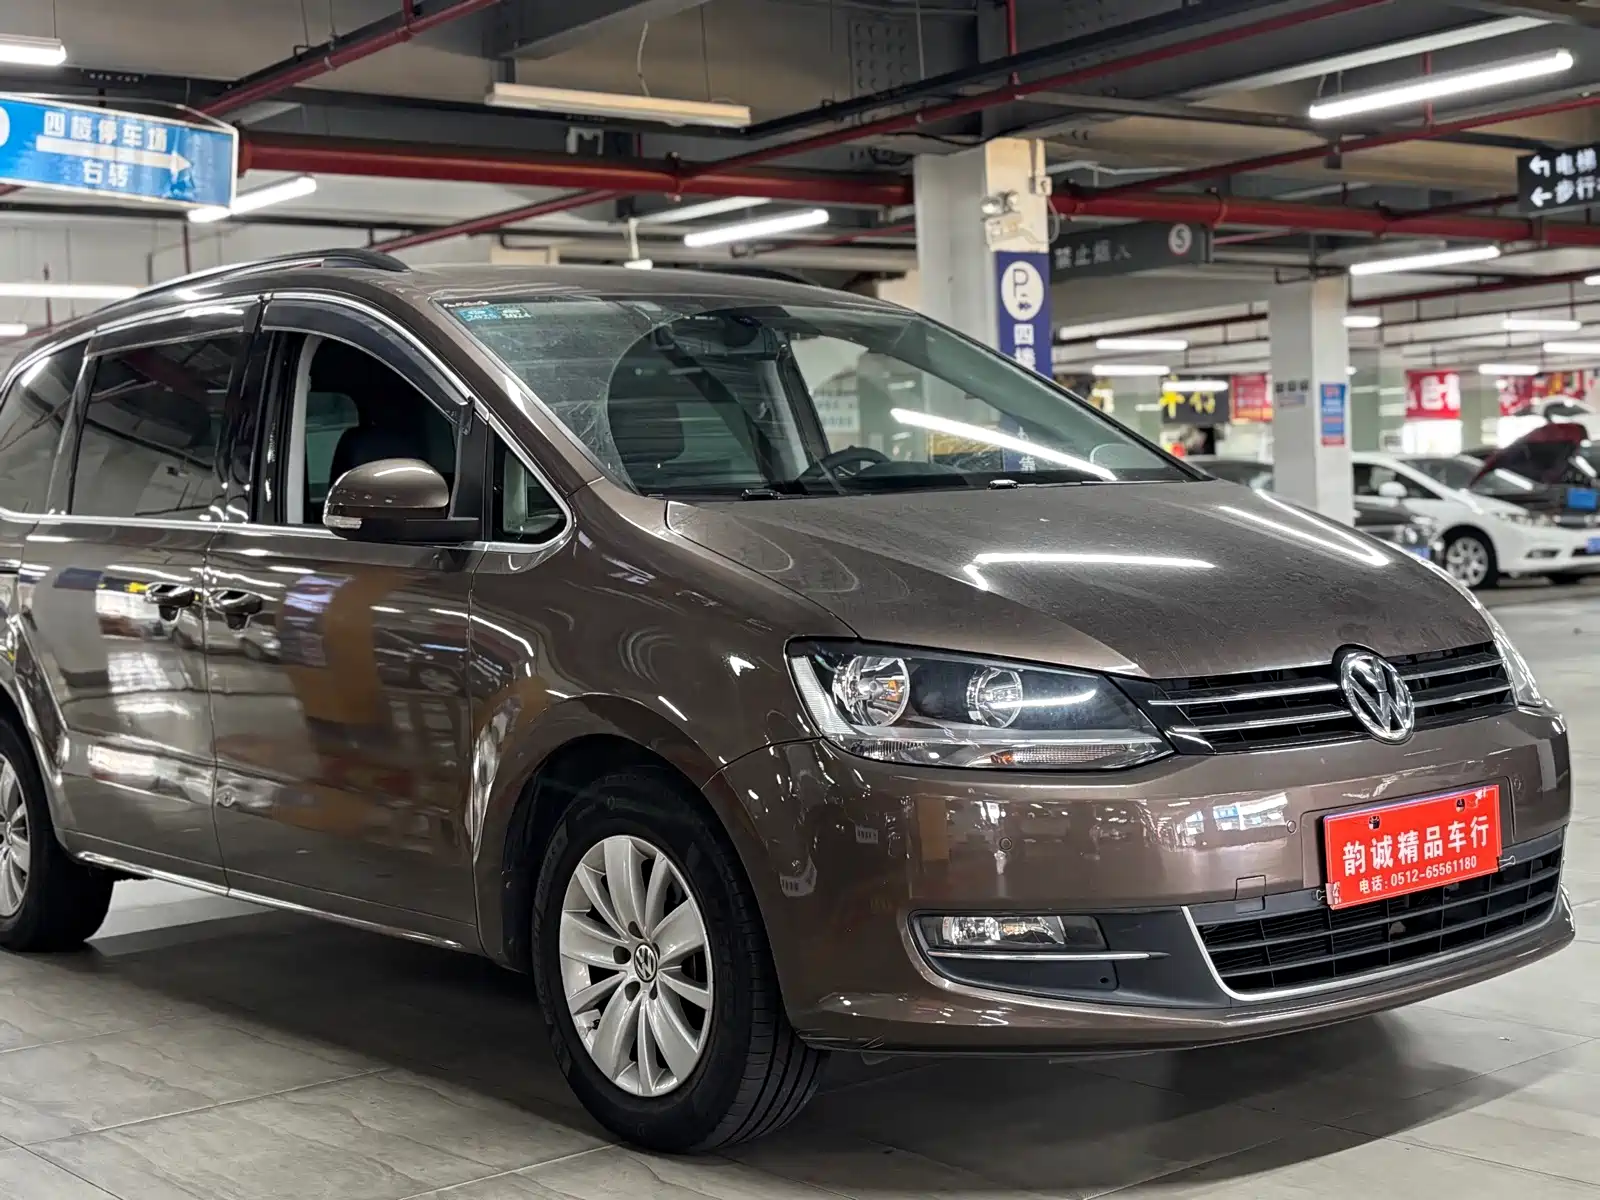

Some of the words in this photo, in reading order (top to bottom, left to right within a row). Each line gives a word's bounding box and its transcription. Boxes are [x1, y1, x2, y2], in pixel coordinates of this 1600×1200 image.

[82, 159, 129, 188] 右转
[1555, 176, 1600, 204] 步行
[1343, 816, 1490, 877] 韵诚精品车行
